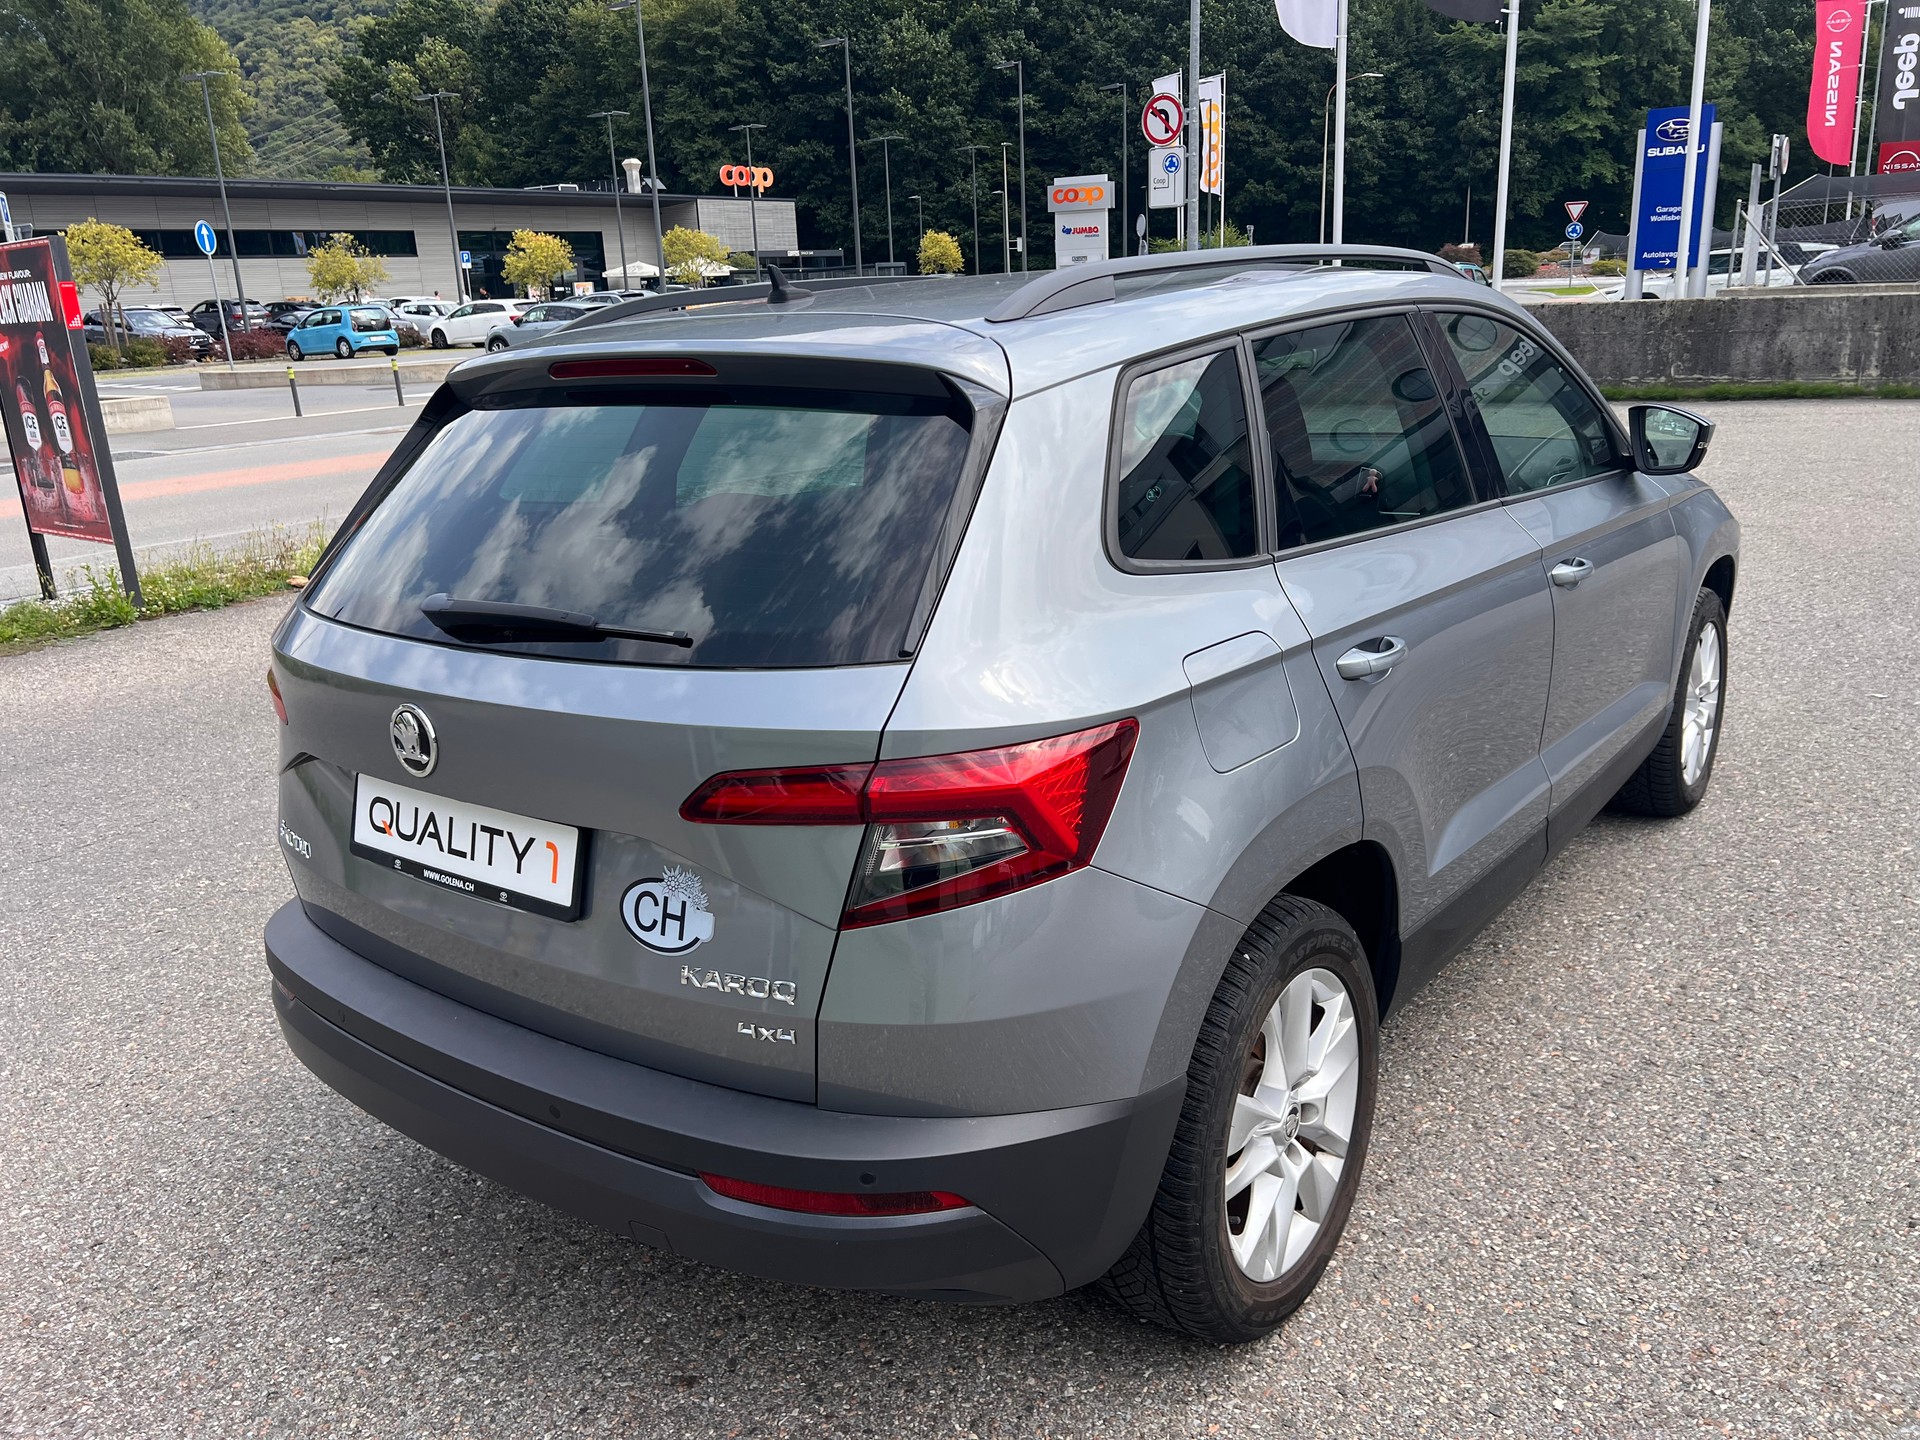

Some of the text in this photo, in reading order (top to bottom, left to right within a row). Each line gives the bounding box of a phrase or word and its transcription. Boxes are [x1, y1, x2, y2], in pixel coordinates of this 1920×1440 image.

[1646, 144, 1706, 157] SUBAU
[719, 164, 774, 193] coop
[1152, 177, 1167, 186] Coop
[1052, 186, 1104, 206] coop
[1656, 205, 1683, 214] Garage
[1072, 226, 1099, 235] JUMBO
[423, 868, 475, 893] WWW.GOLENA.CH
[633, 890, 687, 942] CH
[680, 964, 798, 1006] KAROQ
